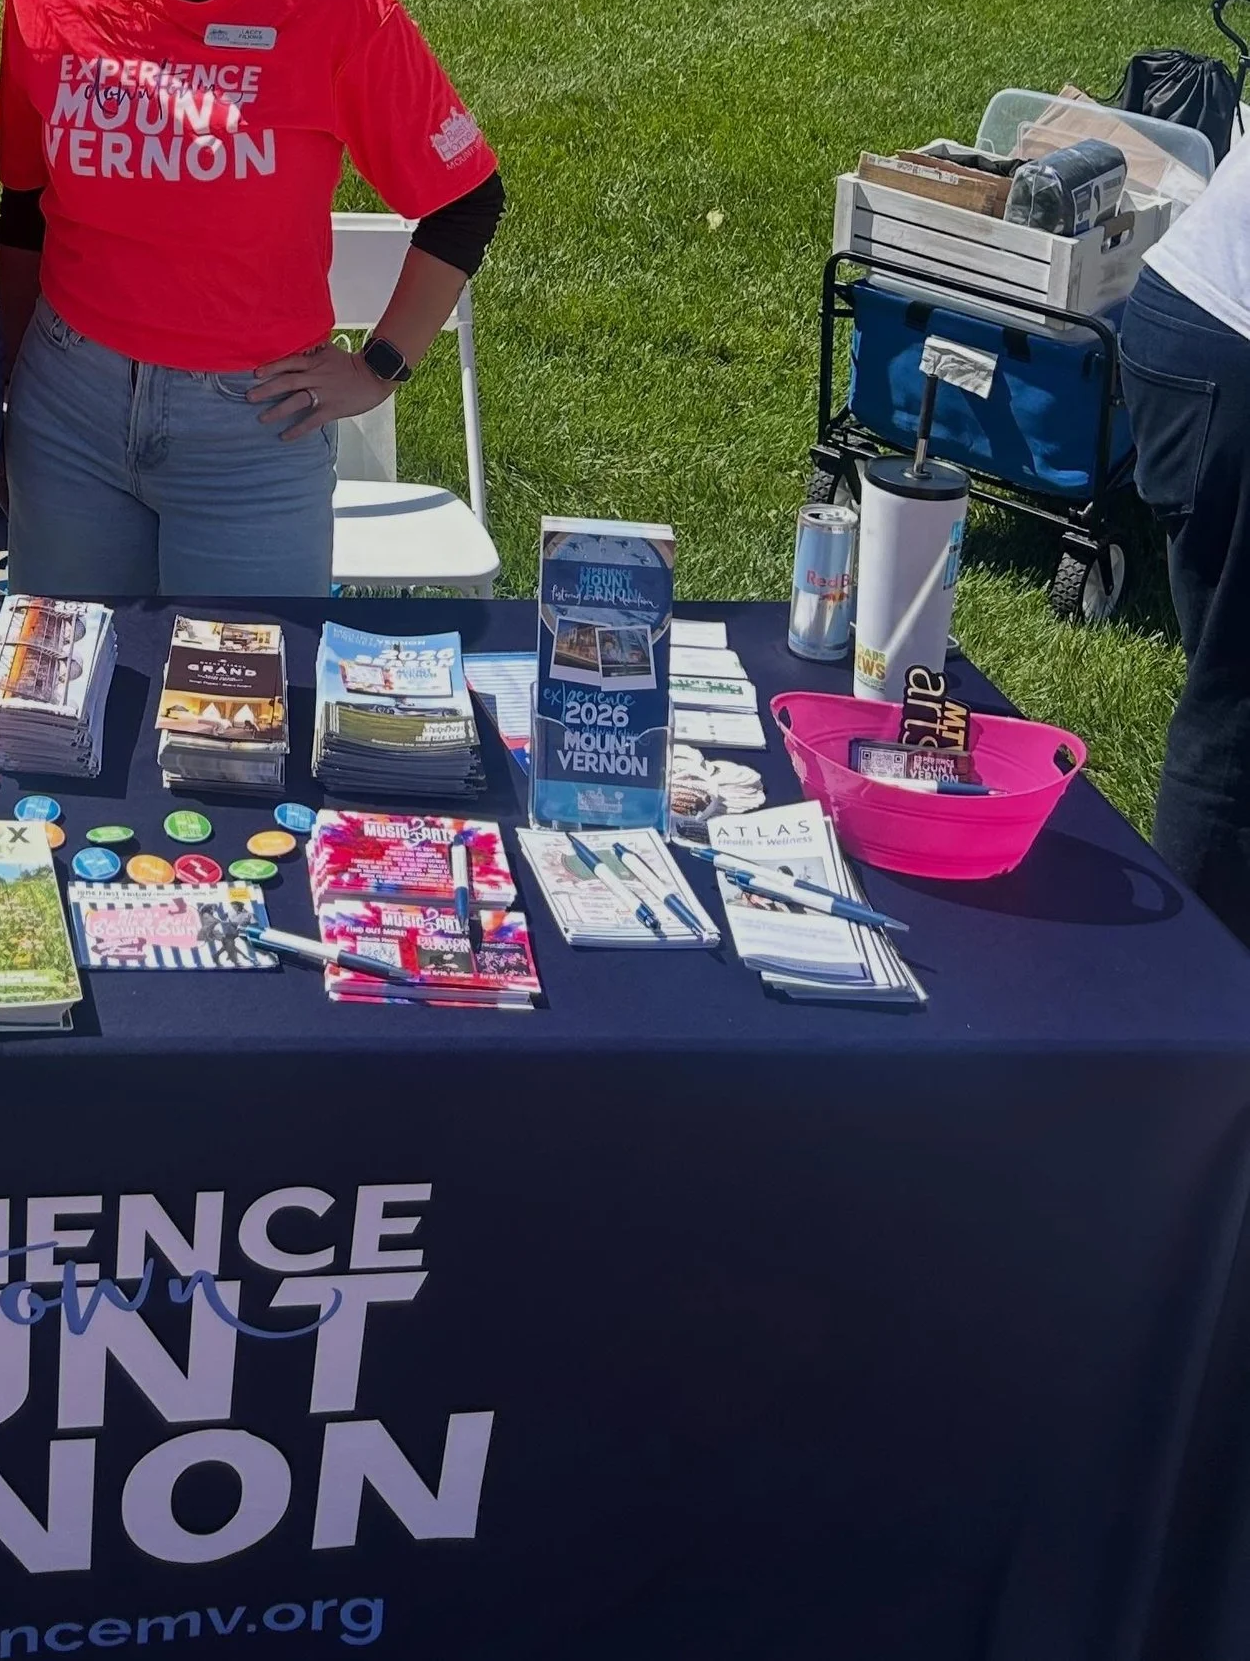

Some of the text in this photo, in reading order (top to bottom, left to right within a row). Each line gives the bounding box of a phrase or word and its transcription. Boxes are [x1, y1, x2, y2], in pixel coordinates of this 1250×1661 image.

[60, 54, 262, 92] EXPERIENCE
[52, 82, 258, 136] MOUNT
[45, 121, 275, 181] VERNON
[580, 566, 632, 578] EXPERIENCE
[806, 570, 839, 587] Red
[580, 573, 633, 589] MOUNT
[575, 584, 638, 601] VERNON
[187, 663, 257, 677] GRAND
[543, 682, 637, 724] experience
[565, 701, 630, 728] 2026
[563, 731, 636, 756] MOUNT
[557, 749, 648, 777] VERNON
[913, 762, 955, 775] MOUNT
[909, 768, 959, 784] VERNON
[363, 823, 410, 839] MUSIC
[716, 820, 810, 838] ATLAS
[718, 837, 753, 846] Health
[766, 836, 813, 846] Wellness
[381, 913, 424, 928] MUSIC
[365, 927, 381, 935] OUT
